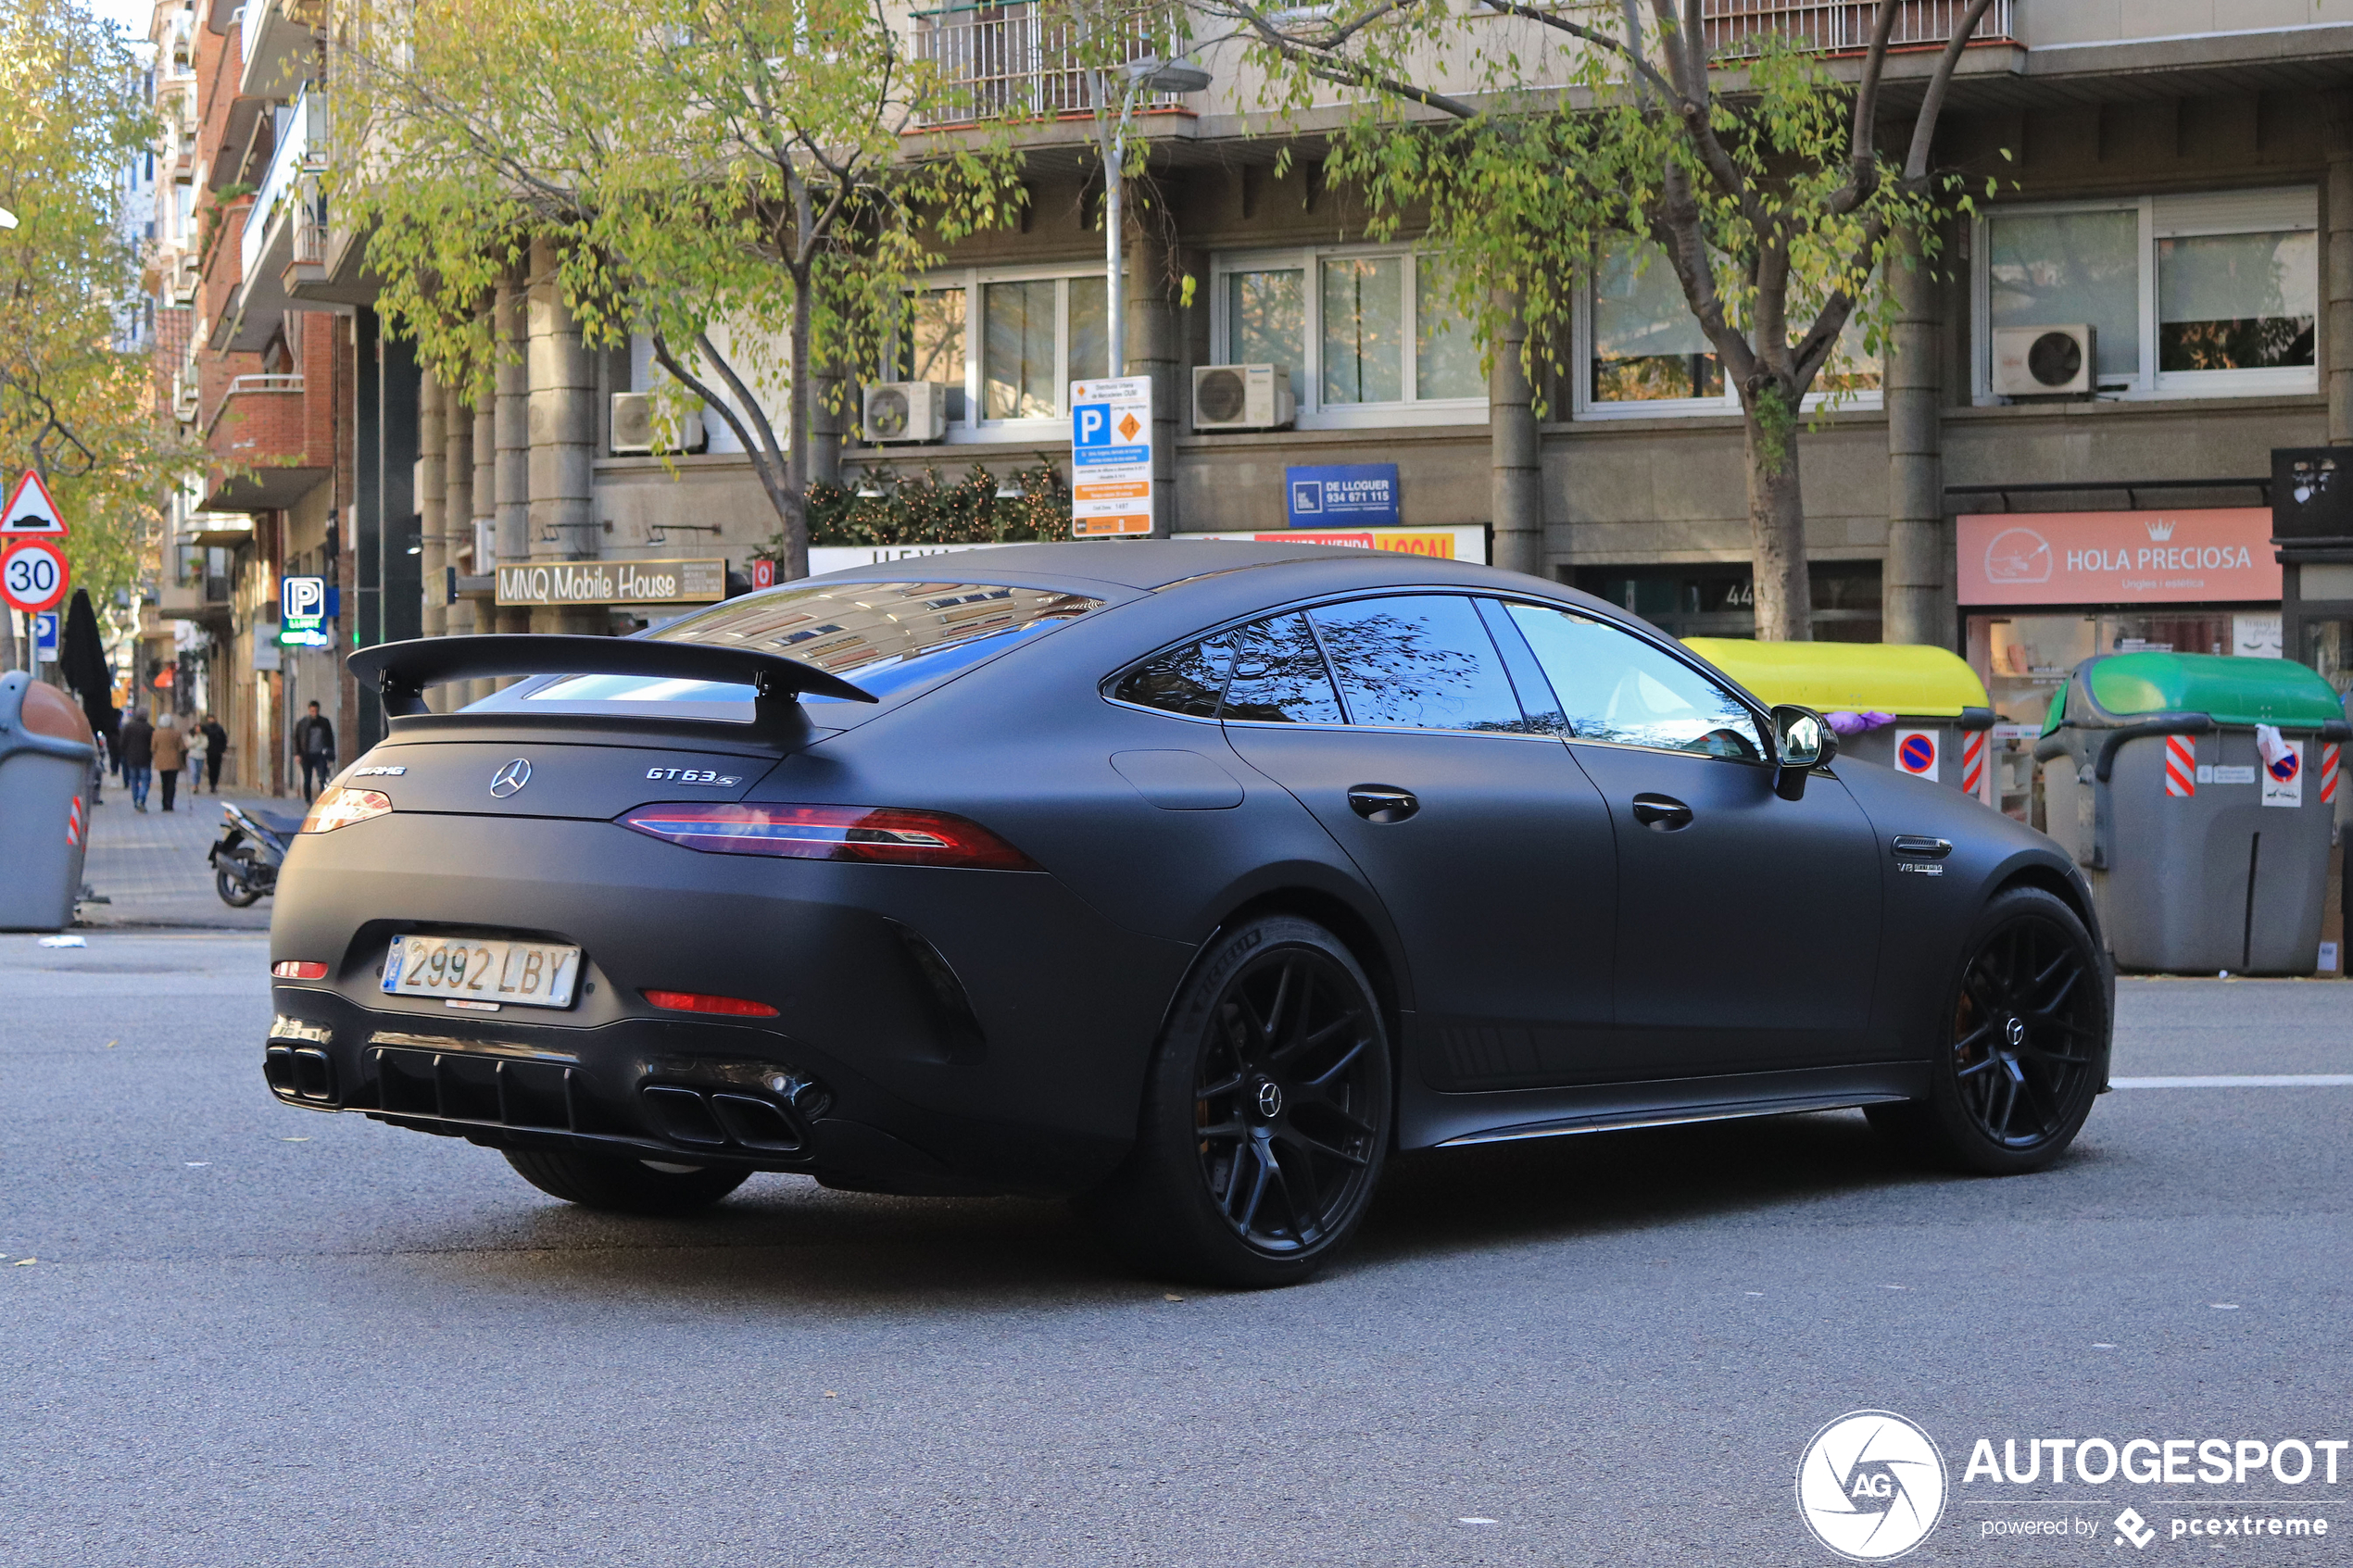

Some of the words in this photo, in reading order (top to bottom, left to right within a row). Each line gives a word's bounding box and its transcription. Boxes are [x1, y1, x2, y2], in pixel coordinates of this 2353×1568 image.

[1081, 409, 1102, 443] P
[1327, 482, 1340, 491] DE
[1342, 480, 1389, 491] LLOGUER
[1327, 493, 1345, 503] 934
[1348, 492, 1366, 502] 671
[1371, 491, 1389, 501] 115
[2067, 548, 2131, 571] HOLA
[2138, 546, 2252, 570] PRECIOSA
[11, 559, 54, 592] 30
[500, 567, 550, 604] MNQ
[555, 565, 613, 600] Mobile
[619, 565, 676, 598] House
[292, 581, 319, 616] P
[368, 765, 407, 776] AMG
[406, 945, 490, 990] 2992
[498, 947, 568, 996] LBY
